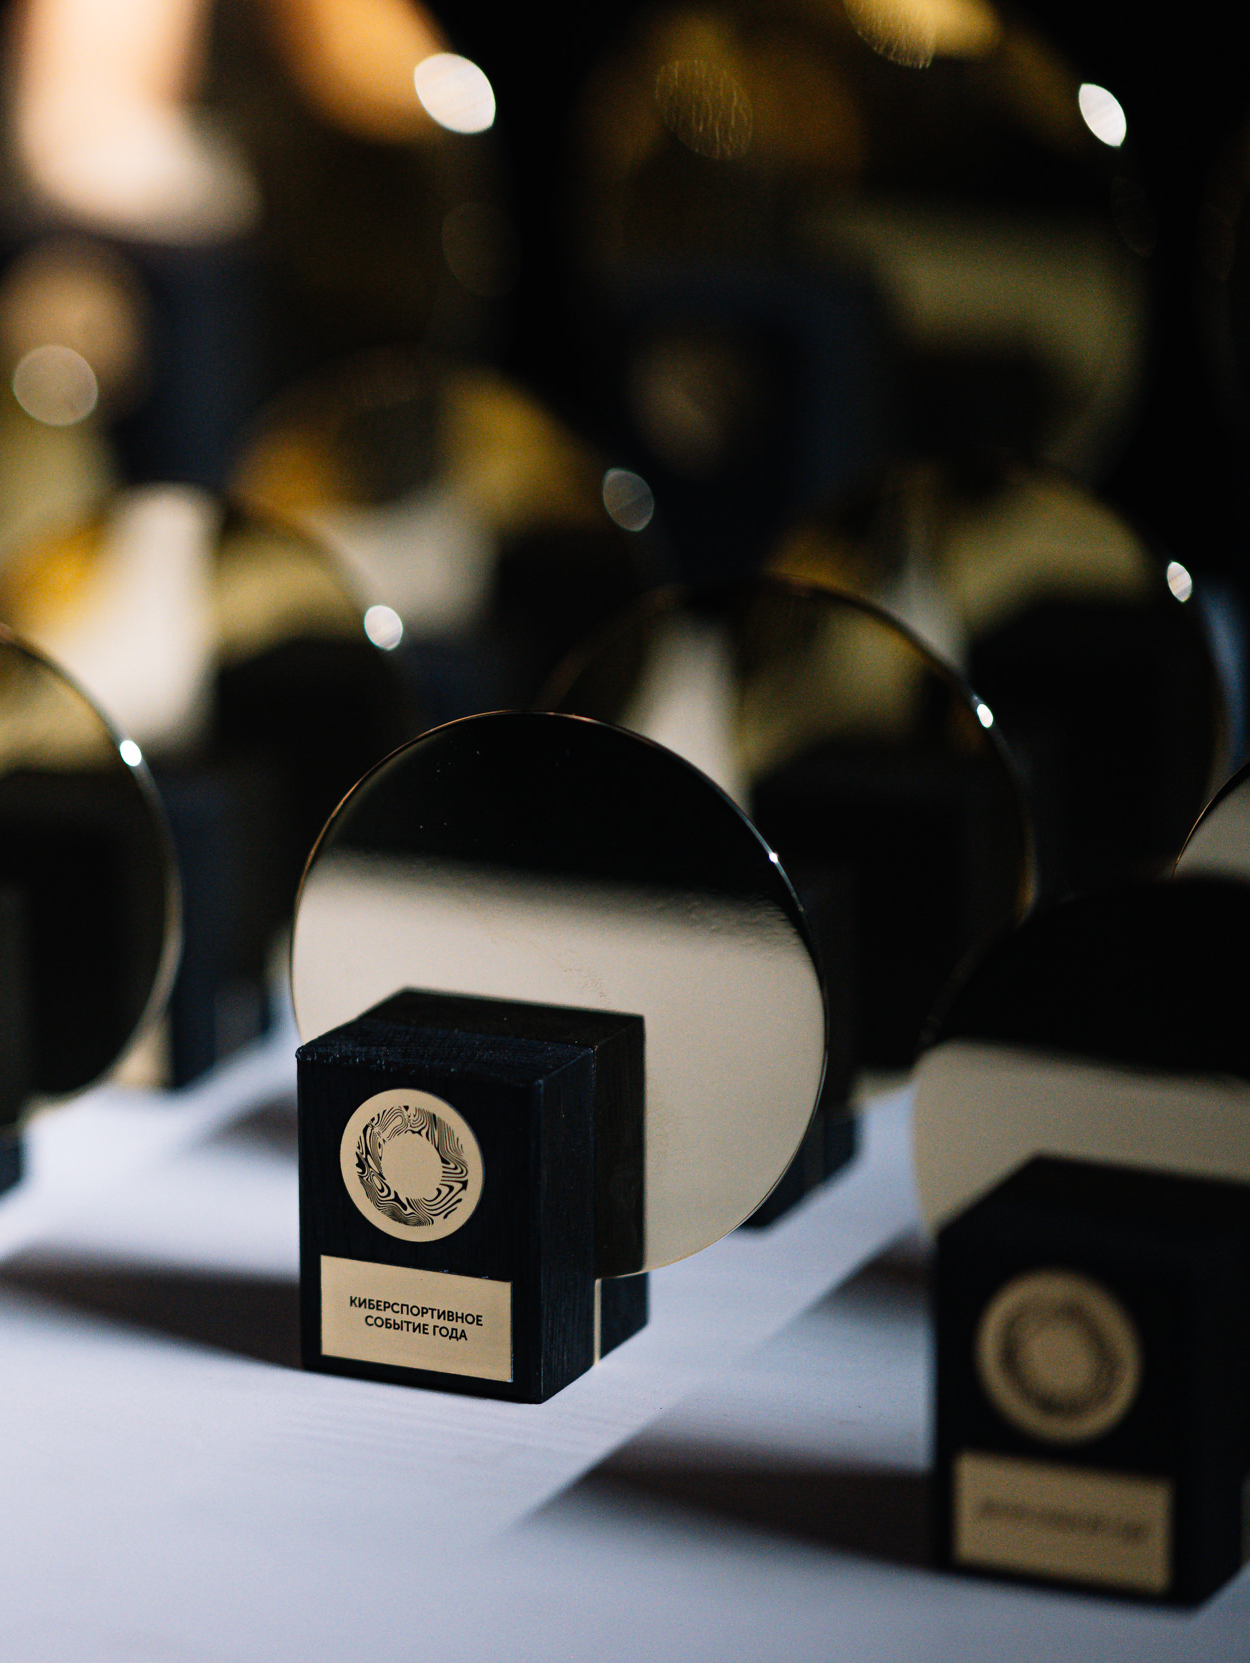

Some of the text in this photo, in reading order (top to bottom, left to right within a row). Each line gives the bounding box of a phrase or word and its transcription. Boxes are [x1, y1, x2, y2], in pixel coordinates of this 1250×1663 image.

[349, 1296, 483, 1326] КИБЕРСПОРТИВНОЕ
[364, 1315, 467, 1341] СОБЫТИЕ ГОДА
